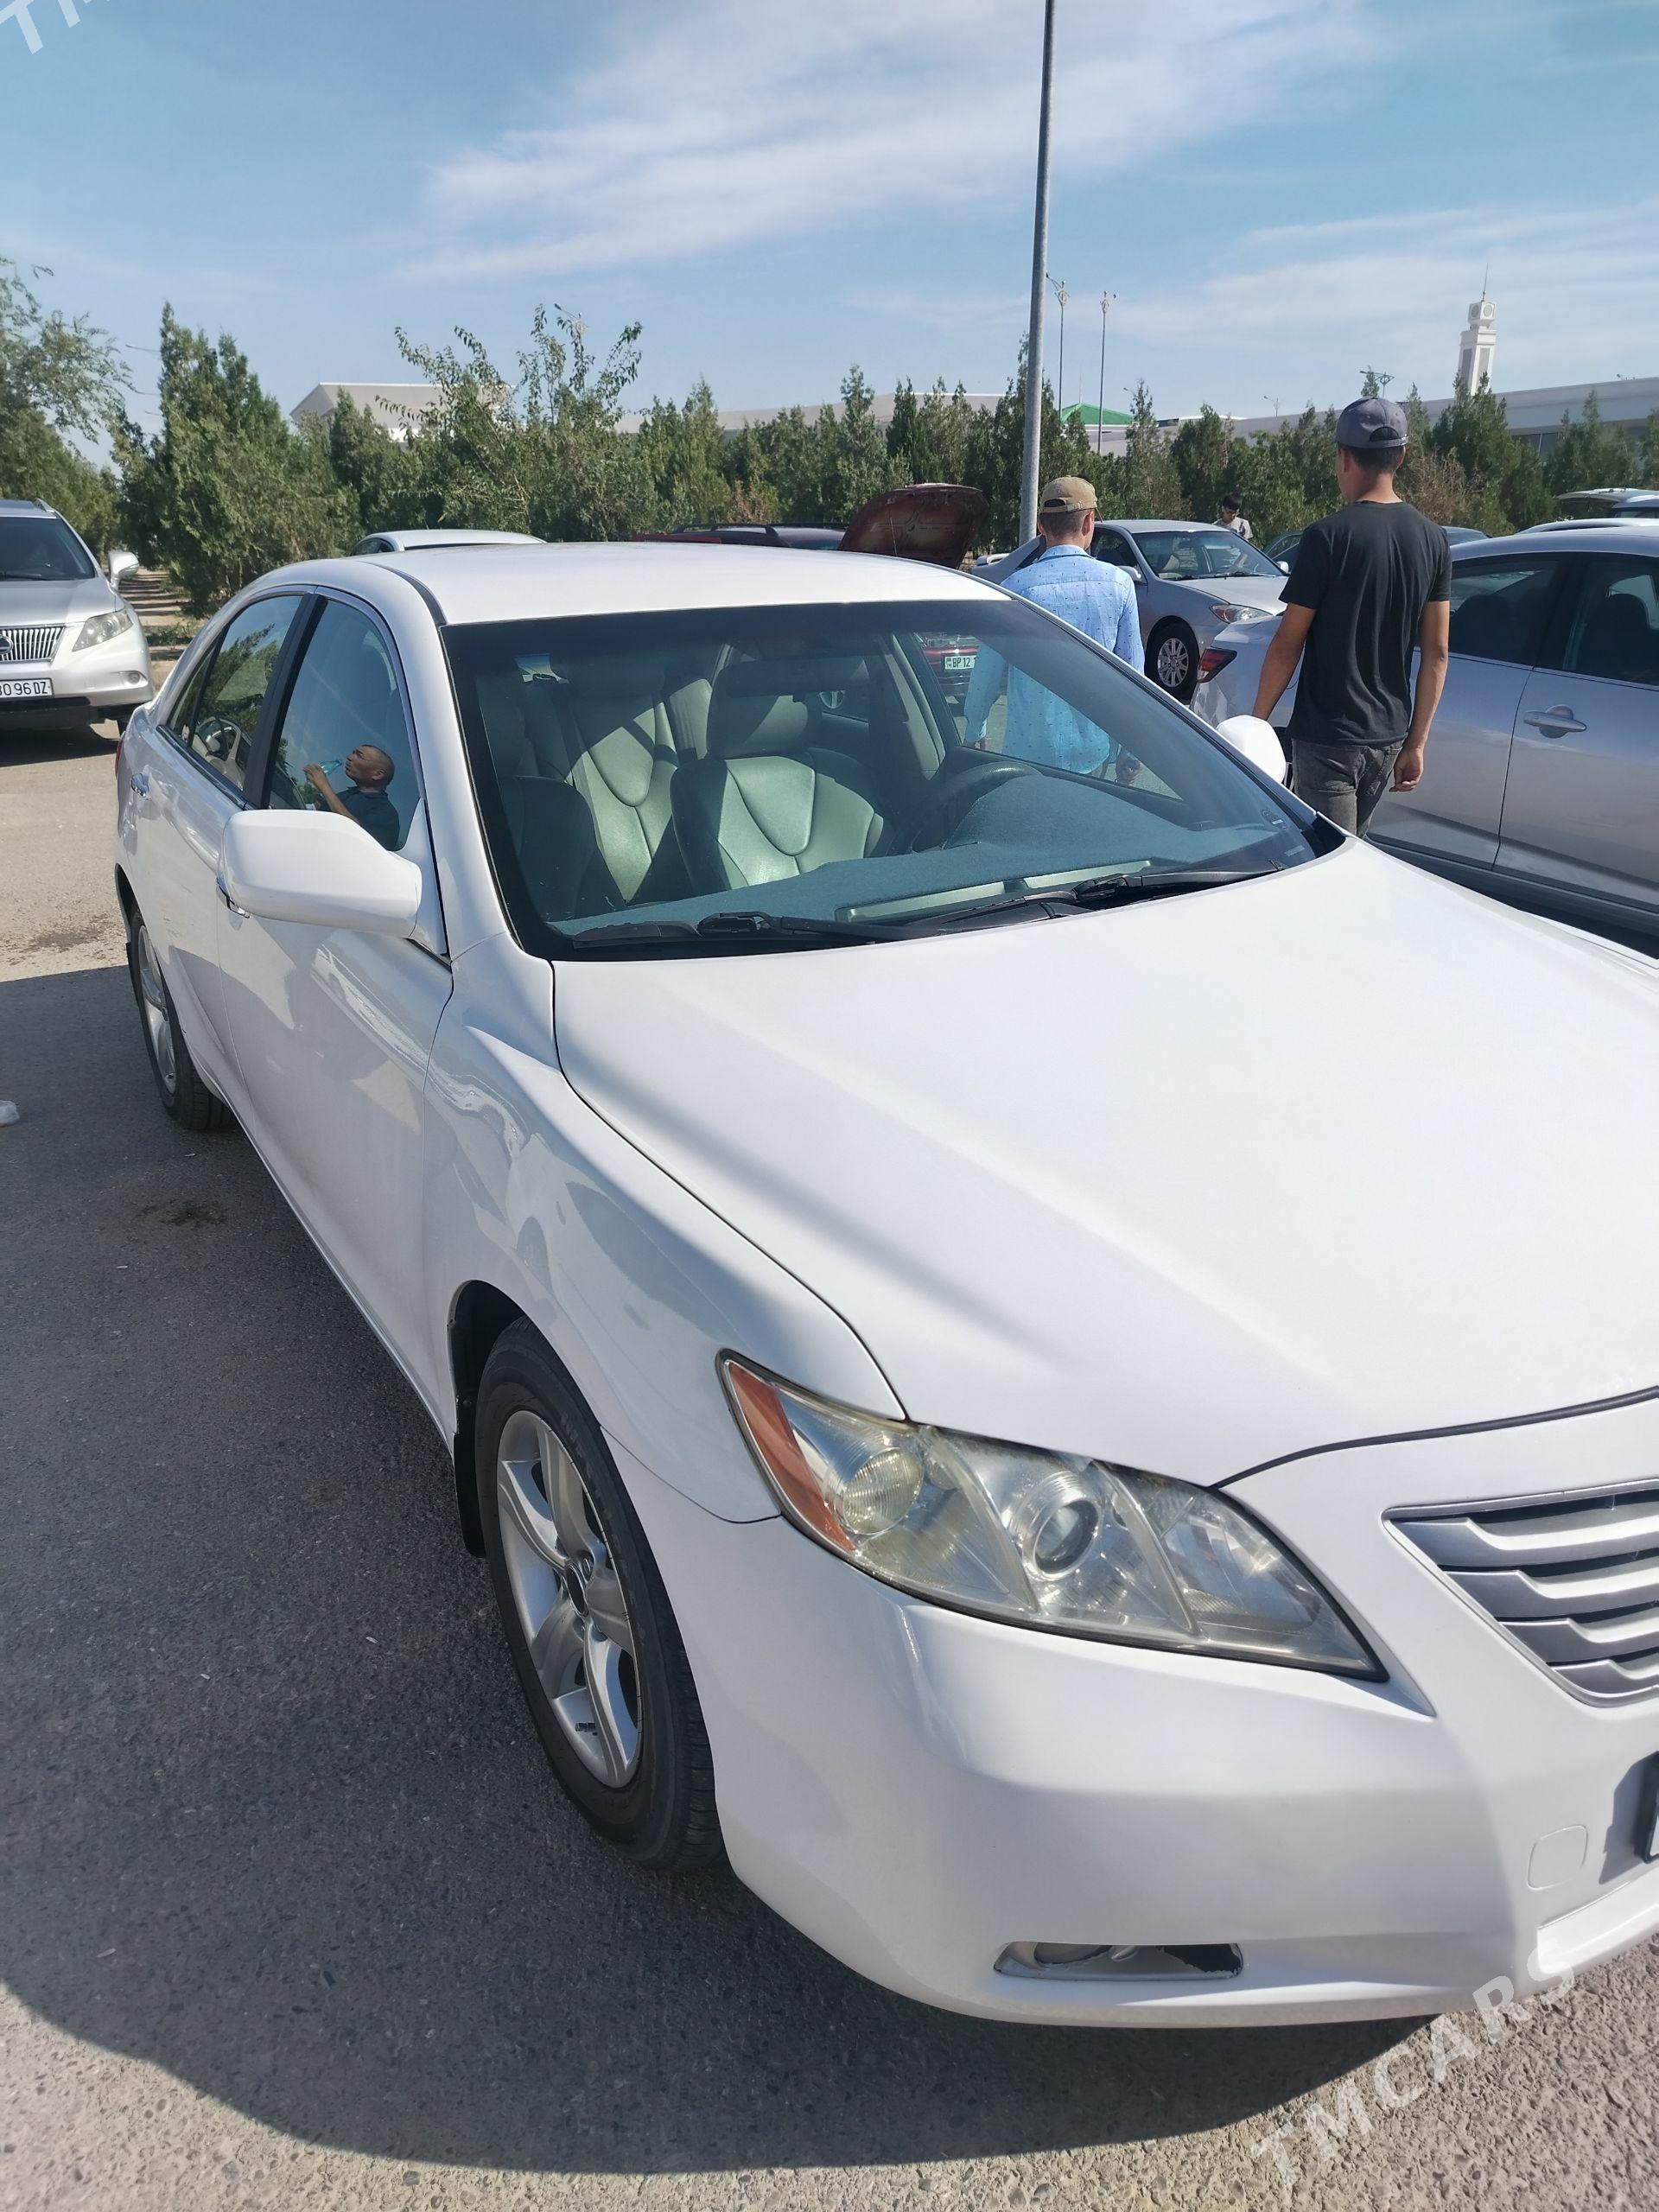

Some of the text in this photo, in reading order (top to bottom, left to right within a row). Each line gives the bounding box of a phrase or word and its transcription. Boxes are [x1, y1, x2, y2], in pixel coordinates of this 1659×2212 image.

[963, 657, 970, 668] 12
[14, 682, 32, 696] 96
[33, 681, 48, 695] DZ
